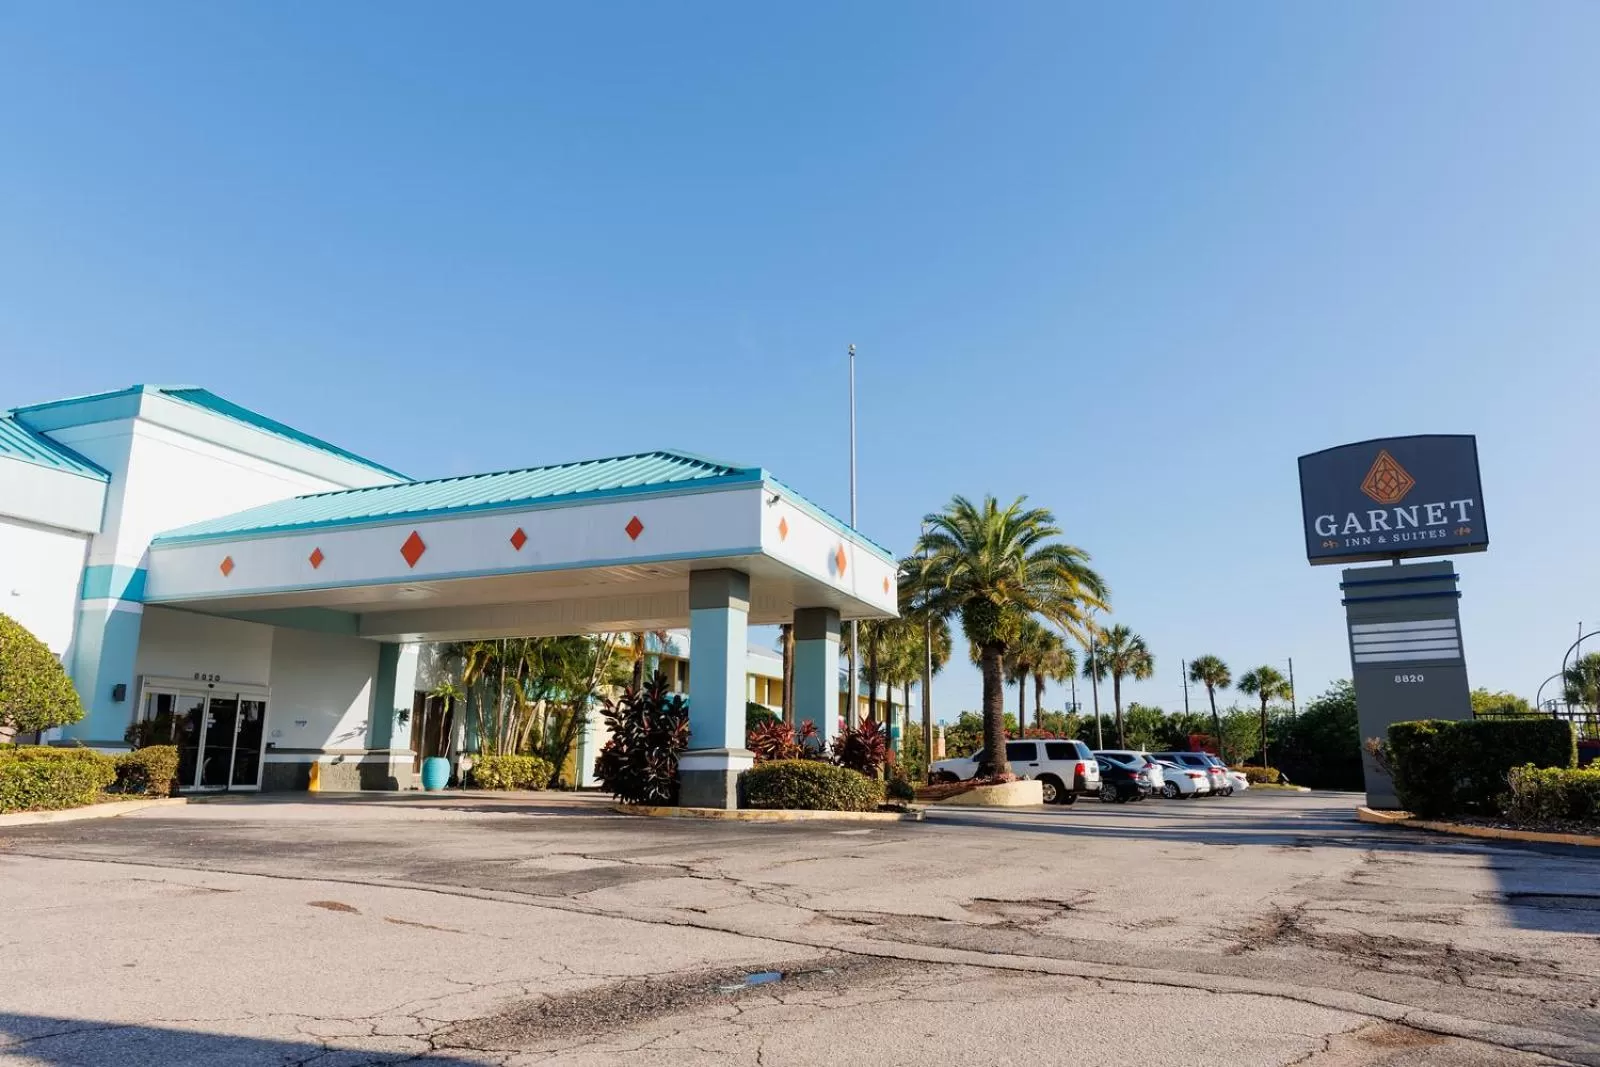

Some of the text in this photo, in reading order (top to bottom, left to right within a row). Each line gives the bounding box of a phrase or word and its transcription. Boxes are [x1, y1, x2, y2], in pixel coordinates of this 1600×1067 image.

[1314, 498, 1474, 537] GARNET
[1345, 529, 1447, 548] INN & SUITES
[1394, 674, 1424, 683] 8820
